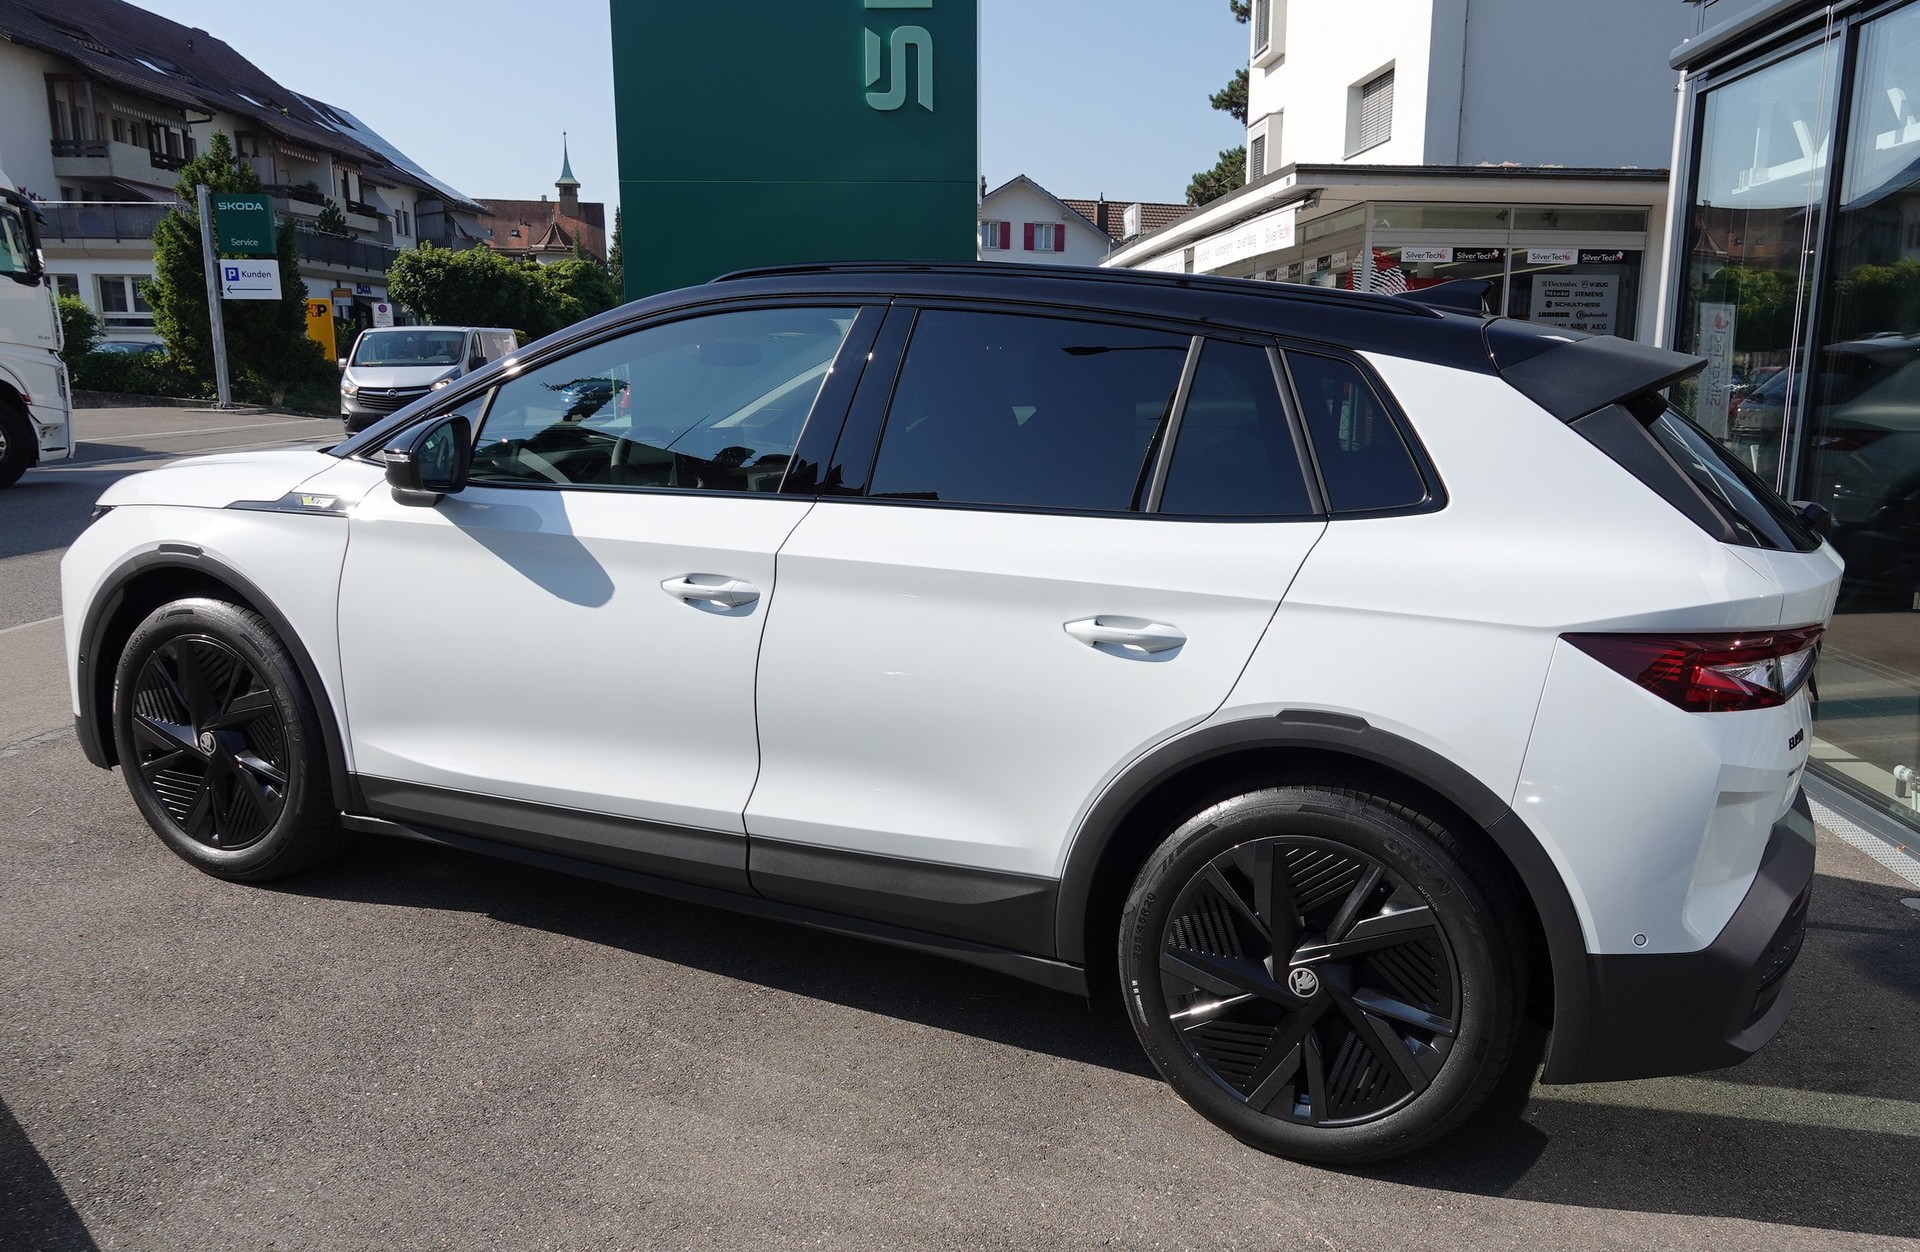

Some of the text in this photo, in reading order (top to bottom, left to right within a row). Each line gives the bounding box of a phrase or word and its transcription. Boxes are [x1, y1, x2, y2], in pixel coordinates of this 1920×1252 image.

[864, 0, 934, 112] S
[217, 202, 264, 211] SKODA
[230, 237, 259, 247] Service
[1405, 251, 1442, 259] SilverTech
[1456, 251, 1494, 260] SilverTech
[1531, 252, 1568, 260] SilverTech
[1581, 253, 1617, 261] SilverTech
[241, 270, 272, 278] Kunden
[1417, 885, 1440, 912] OUTSIDE
